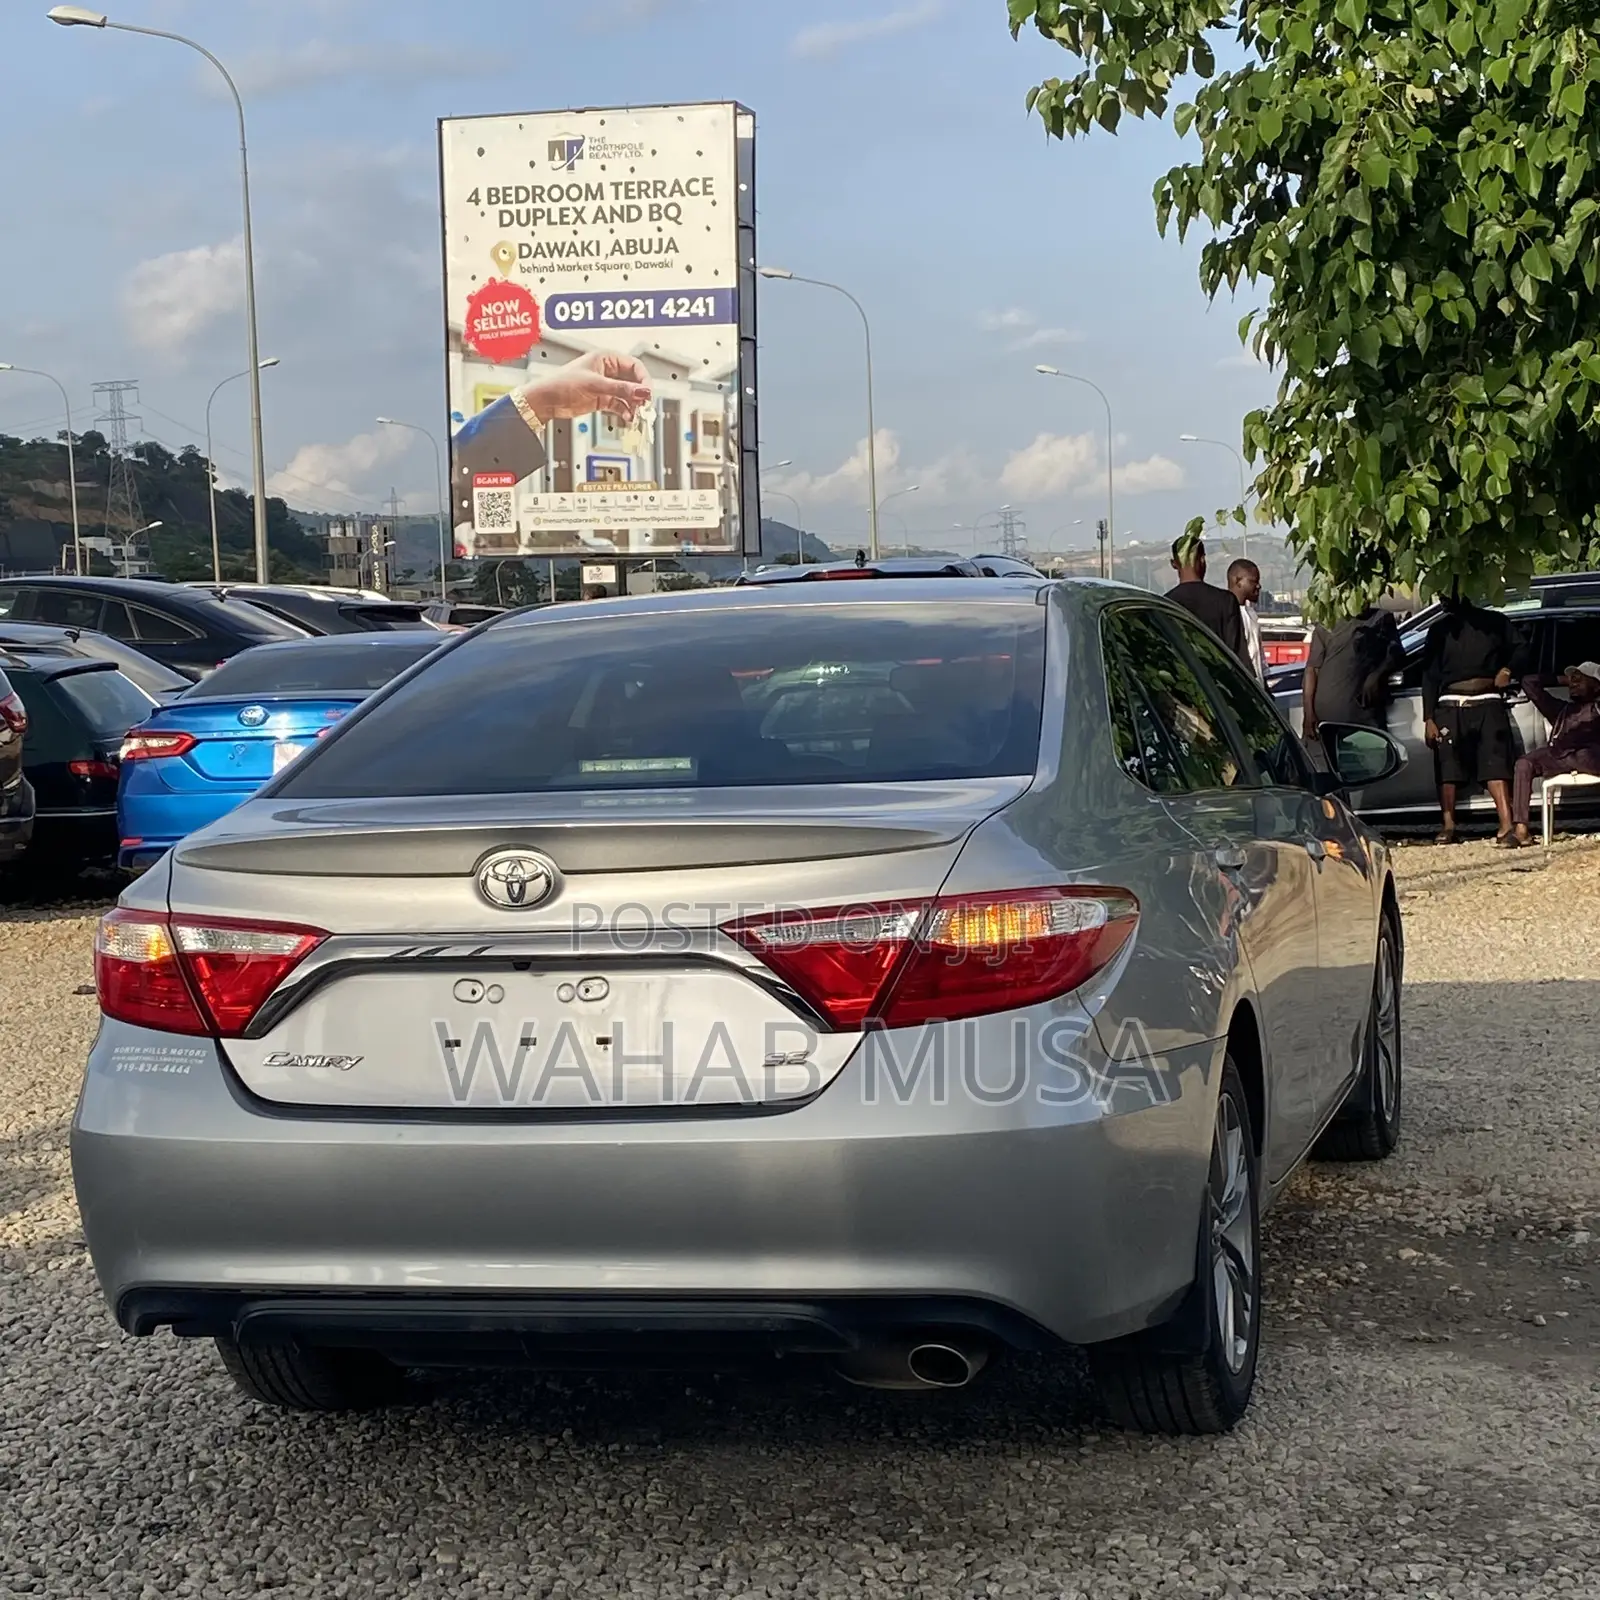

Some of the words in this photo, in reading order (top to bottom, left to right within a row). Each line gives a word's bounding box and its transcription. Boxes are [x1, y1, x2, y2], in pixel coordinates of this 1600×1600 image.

[588, 136, 606, 144] THE
[588, 142, 645, 152] NORTHPOLE
[588, 151, 623, 160] REALTY
[624, 150, 644, 159] LTD.
[466, 187, 481, 206] 4
[486, 182, 605, 206] BEDROOM
[609, 176, 715, 201] TERRACE
[498, 205, 588, 229] DUPLEX
[591, 203, 643, 225] AND
[648, 201, 683, 226] BQ
[518, 239, 600, 260] DAWAKI
[519, 262, 555, 274] behind
[556, 261, 593, 273] Market
[634, 258, 674, 271] Dawaki
[481, 298, 520, 317] NOW
[554, 300, 595, 322] 091
[600, 298, 654, 321] 2021
[660, 295, 716, 320] 4241
[473, 311, 533, 333] SELLING
[476, 476, 499, 485] SCAN
[583, 484, 612, 492] ESTATE
[113, 1046, 141, 1054] NORTH
[142, 1047, 168, 1055] HILLS
[170, 1048, 208, 1057] MOTORS
